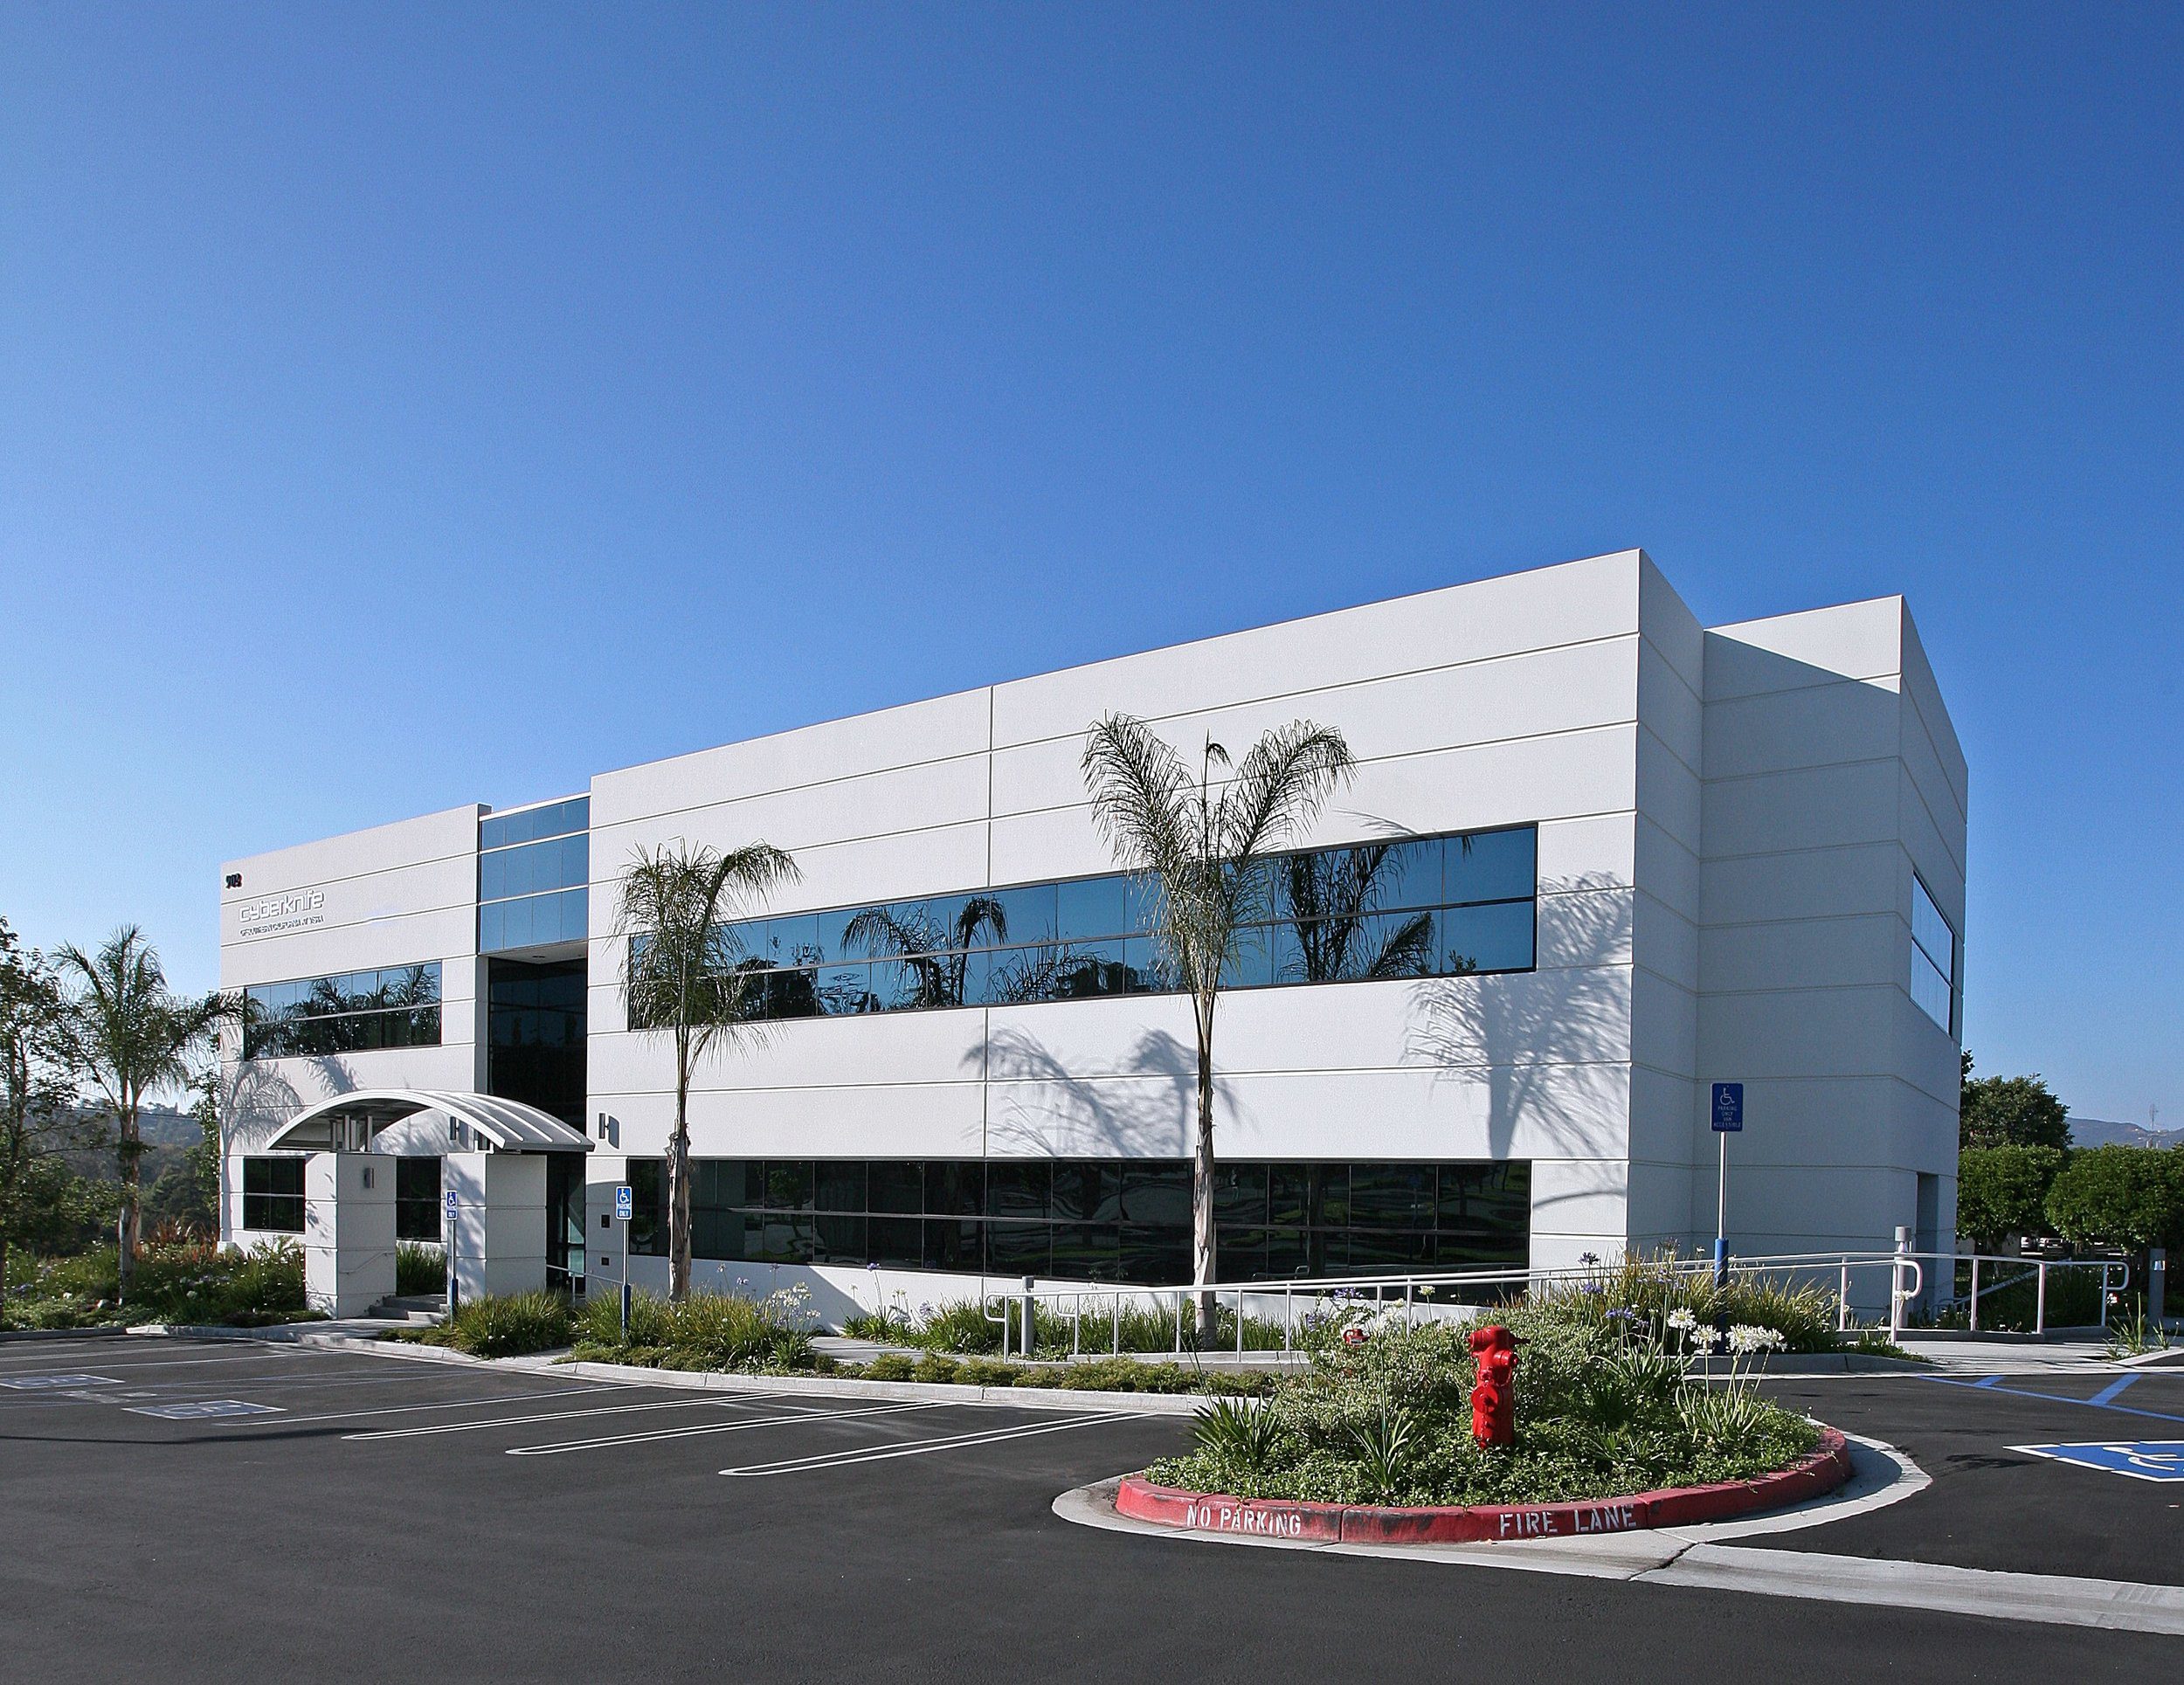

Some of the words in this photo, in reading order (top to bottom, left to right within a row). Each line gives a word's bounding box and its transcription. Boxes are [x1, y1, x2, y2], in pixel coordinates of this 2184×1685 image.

[1186, 1505, 1211, 1527] NO
[1220, 1508, 1301, 1536] PARKING
[1499, 1510, 1558, 1537] FIRE
[1574, 1504, 1636, 1532] LANE
